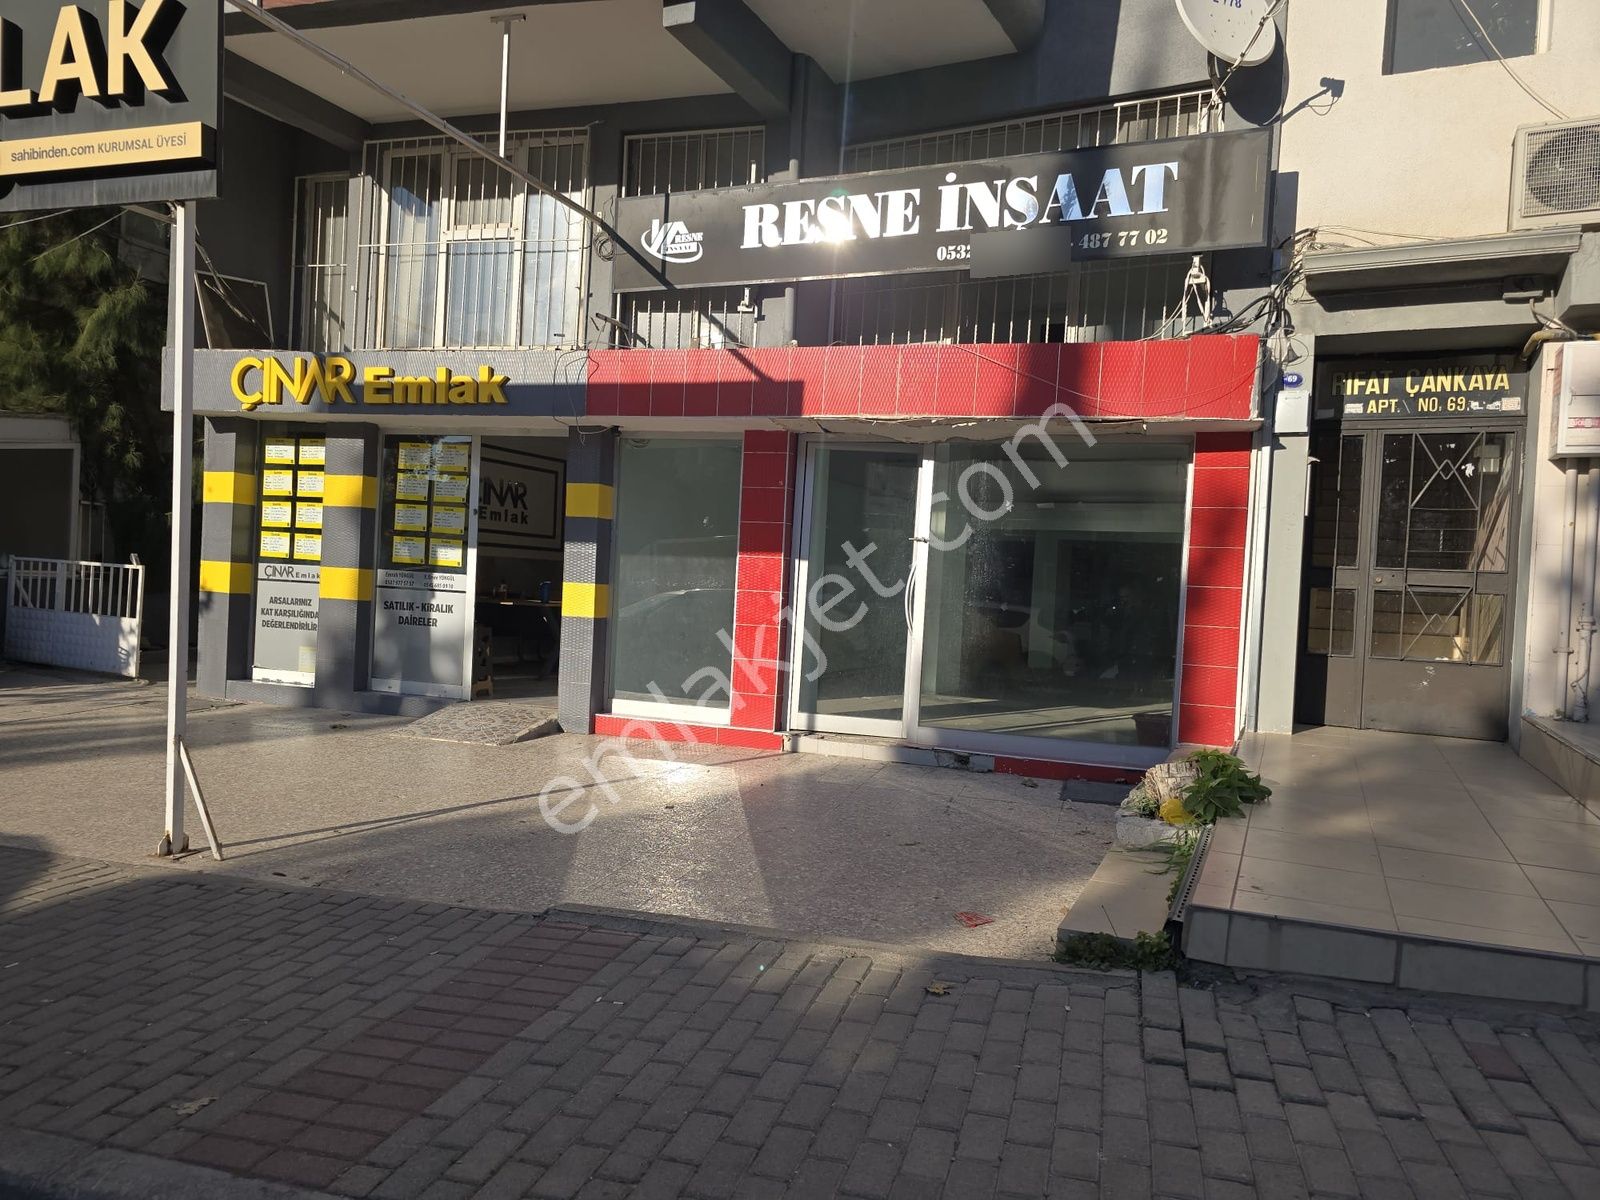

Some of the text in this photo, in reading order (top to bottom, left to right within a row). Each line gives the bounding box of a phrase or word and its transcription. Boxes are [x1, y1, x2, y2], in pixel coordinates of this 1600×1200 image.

[11, 132, 187, 162] sahibinden.com KURUMSAL ÜYESİ
[740, 161, 1179, 250] RESNE İNŞAAT
[1079, 232, 1112, 249] 487
[1118, 230, 1140, 247] 77
[1144, 228, 1168, 245] 02
[230, 355, 511, 411] ÇINAR Emlak
[1405, 365, 1510, 398] ÇANKAYA
[479, 476, 528, 510] INAR
[478, 505, 528, 525] Emlak
[264, 565, 320, 579] ÇINAR Emlak
[261, 607, 273, 616] KAT
[383, 600, 415, 612] SATILIK
[398, 614, 438, 628] DAİRELER
